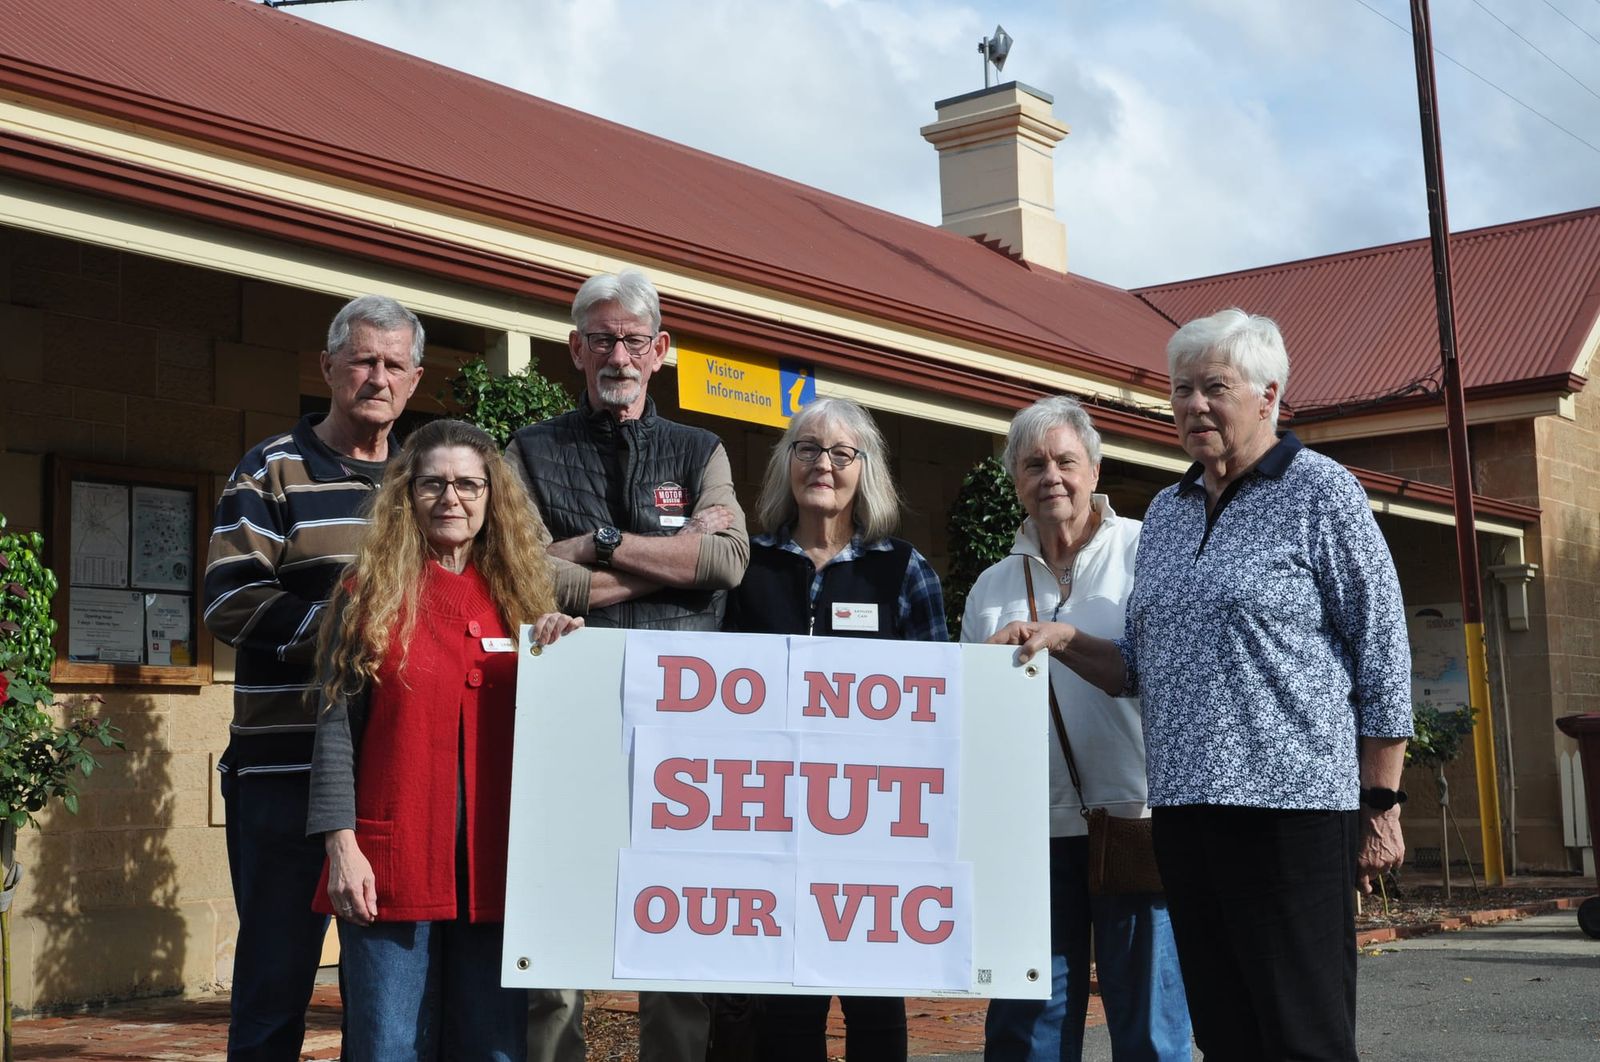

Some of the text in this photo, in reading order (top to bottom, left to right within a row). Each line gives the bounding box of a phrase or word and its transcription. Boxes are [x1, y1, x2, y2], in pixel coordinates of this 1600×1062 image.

[706, 358, 745, 381] Visitor
[706, 380, 772, 407] Information
[658, 491, 683, 499] MOTOR
[802, 671, 946, 722] NOT
[651, 757, 945, 838] SHUT
[633, 882, 955, 945] OUR VIC
